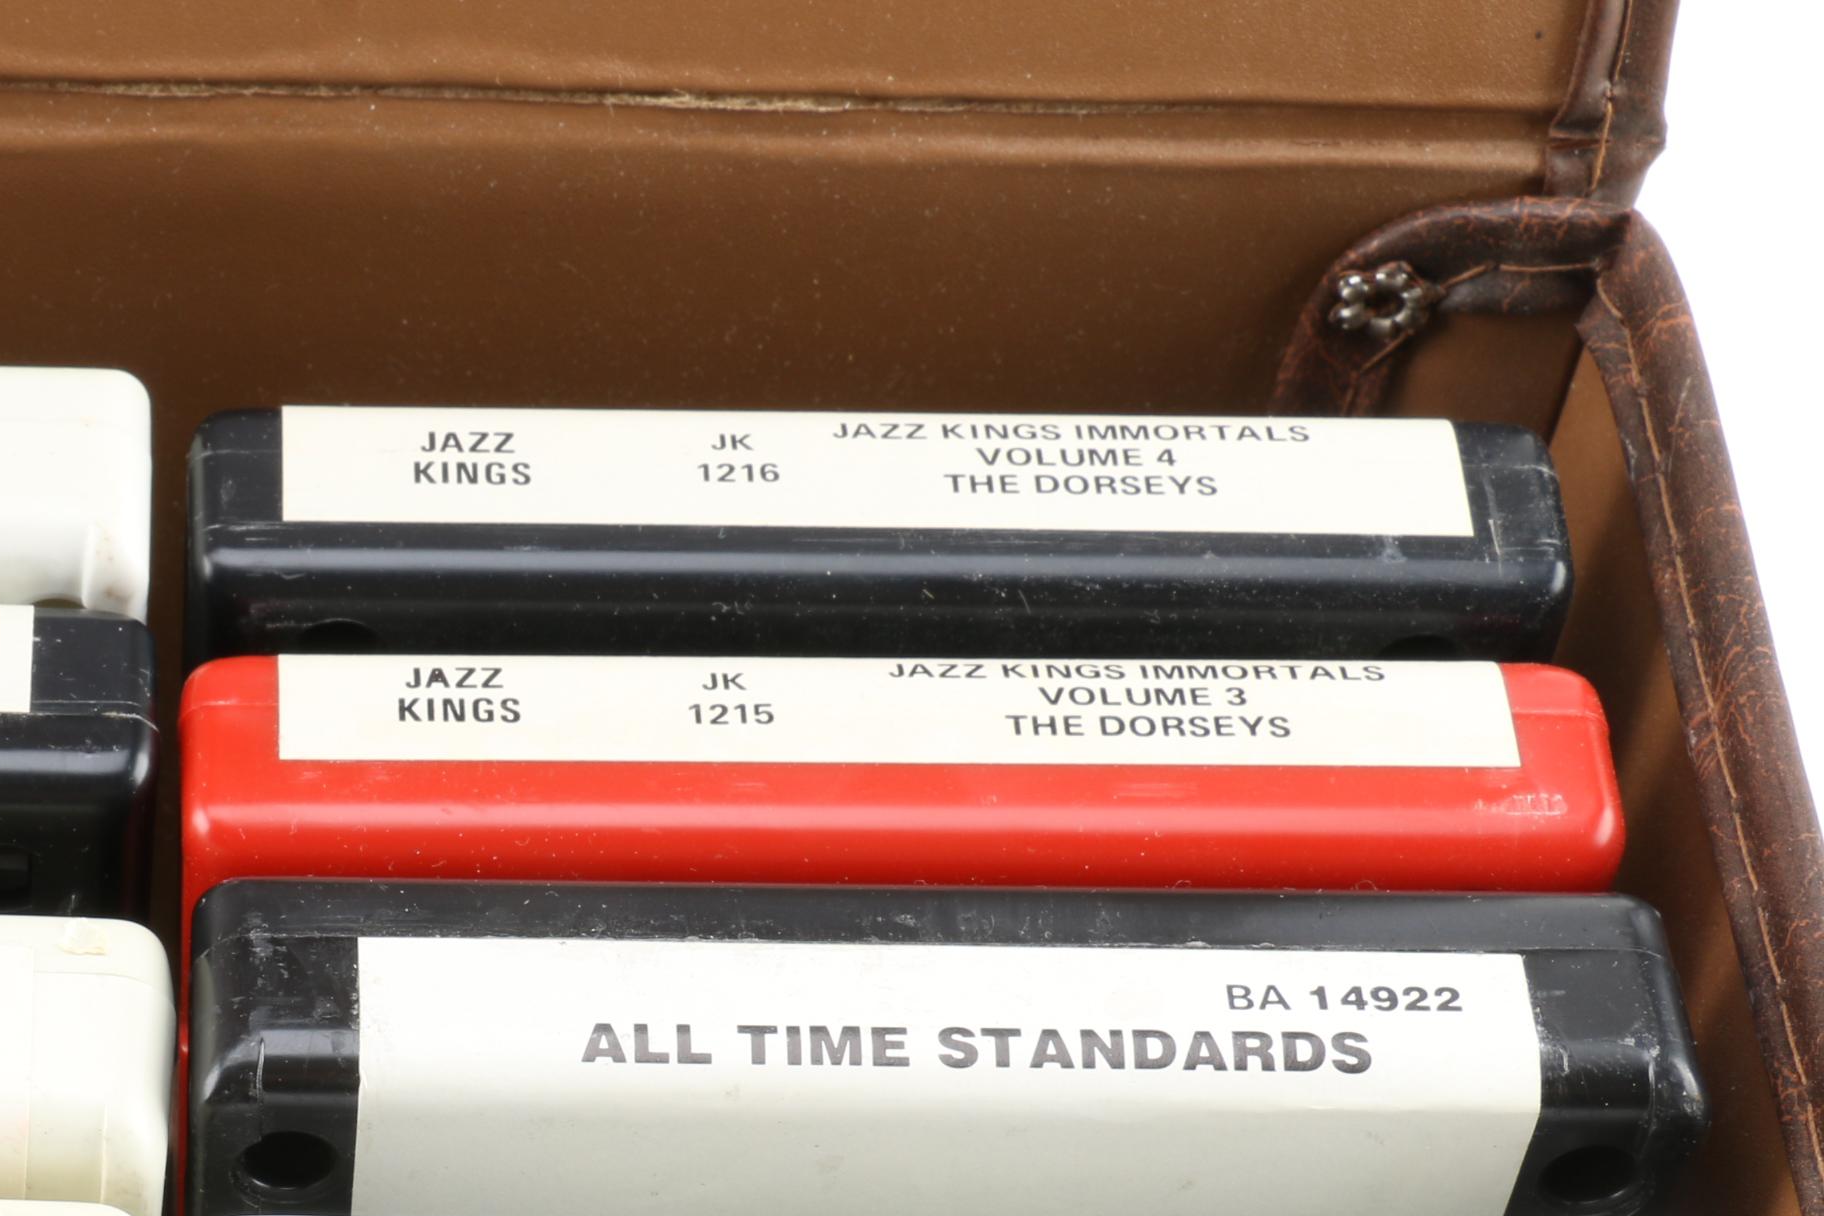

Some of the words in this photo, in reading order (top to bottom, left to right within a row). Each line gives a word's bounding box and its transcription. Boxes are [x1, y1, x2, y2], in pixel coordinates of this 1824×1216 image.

[712, 434, 751, 450] JK
[834, 423, 925, 439] JAZZ
[942, 424, 1061, 440] KINGS
[1075, 425, 1309, 441] IMMORTALS
[422, 432, 513, 453] JAZZ
[977, 448, 1141, 466] VOLUME
[1157, 449, 1175, 466] 4
[414, 462, 530, 485] KINGS
[699, 464, 779, 482] 1216
[945, 475, 1018, 493] THE
[1035, 475, 1217, 495] DORSEYS
[406, 668, 503, 688] JAZZ
[703, 673, 745, 690] JK
[890, 664, 985, 678] JAZZ
[1002, 664, 1125, 679] KINGS
[1140, 665, 1384, 680] IMMORTALS
[1039, 687, 1210, 705] VOLUME
[1226, 688, 1246, 705] 3
[399, 698, 520, 723] KINGS
[689, 704, 774, 724] 1215
[1006, 716, 1083, 735] THE
[1100, 716, 1290, 737] DORSEYS
[1227, 985, 1291, 1010] BA
[1310, 986, 1462, 1011] 14922
[582, 1023, 712, 1064] ALL
[737, 1025, 910, 1067] TIME
[939, 1027, 1371, 1074] STANDARDS
